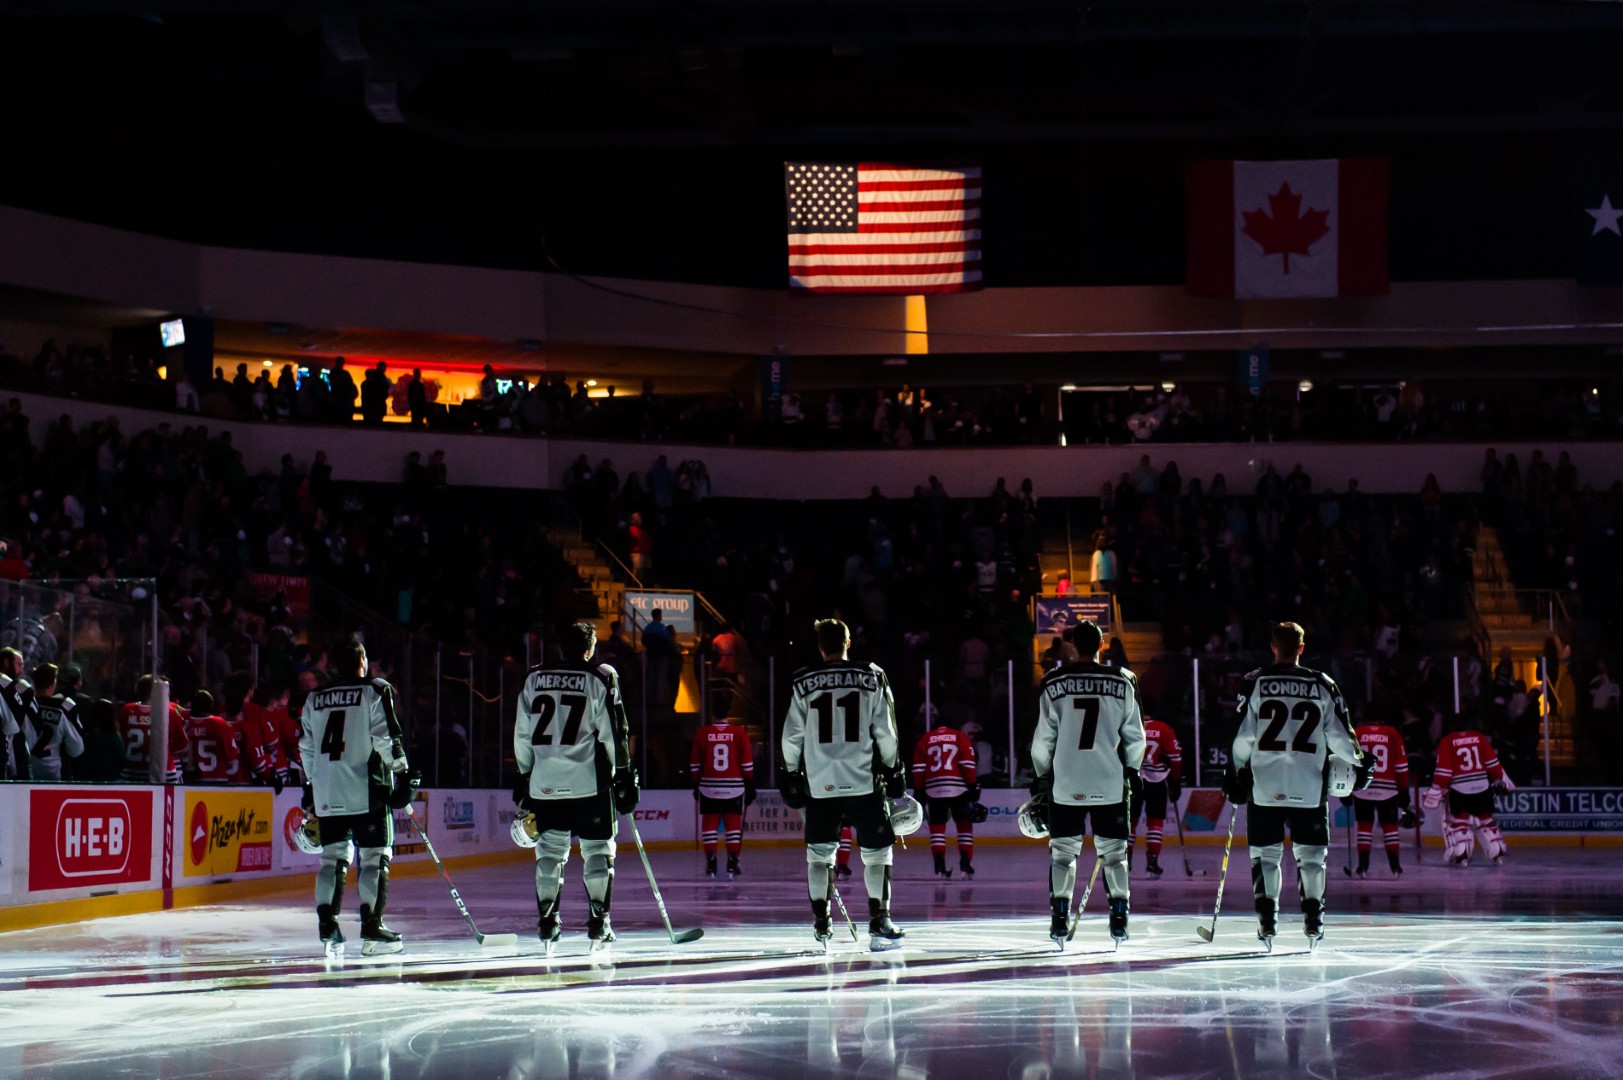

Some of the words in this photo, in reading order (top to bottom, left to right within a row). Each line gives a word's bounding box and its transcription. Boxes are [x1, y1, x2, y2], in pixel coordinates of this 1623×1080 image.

[652, 597, 689, 613] group
[535, 674, 586, 691] MERSCH
[797, 672, 877, 696] L'ESPERANCE
[1047, 678, 1125, 700] BAYREUTHER
[1260, 681, 1320, 698] CONDRA
[314, 690, 361, 709] HANLEY
[128, 714, 152, 726] NILSS
[531, 694, 587, 746] 27
[810, 691, 860, 744] 11
[1073, 697, 1100, 751] 7
[1257, 699, 1321, 754] 22
[127, 728, 152, 763] 2
[320, 710, 346, 762] 4
[197, 738, 218, 773] 5
[713, 743, 730, 772] 8
[927, 744, 959, 773] 37
[1144, 740, 1160, 764] 7
[1456, 745, 1483, 771] 31
[633, 809, 670, 820] CCM
[1493, 792, 1560, 813] AUSTIN
[209, 815, 236, 854] Pizza
[236, 808, 256, 841] Hut
[1548, 819, 1589, 829] CREDIT
